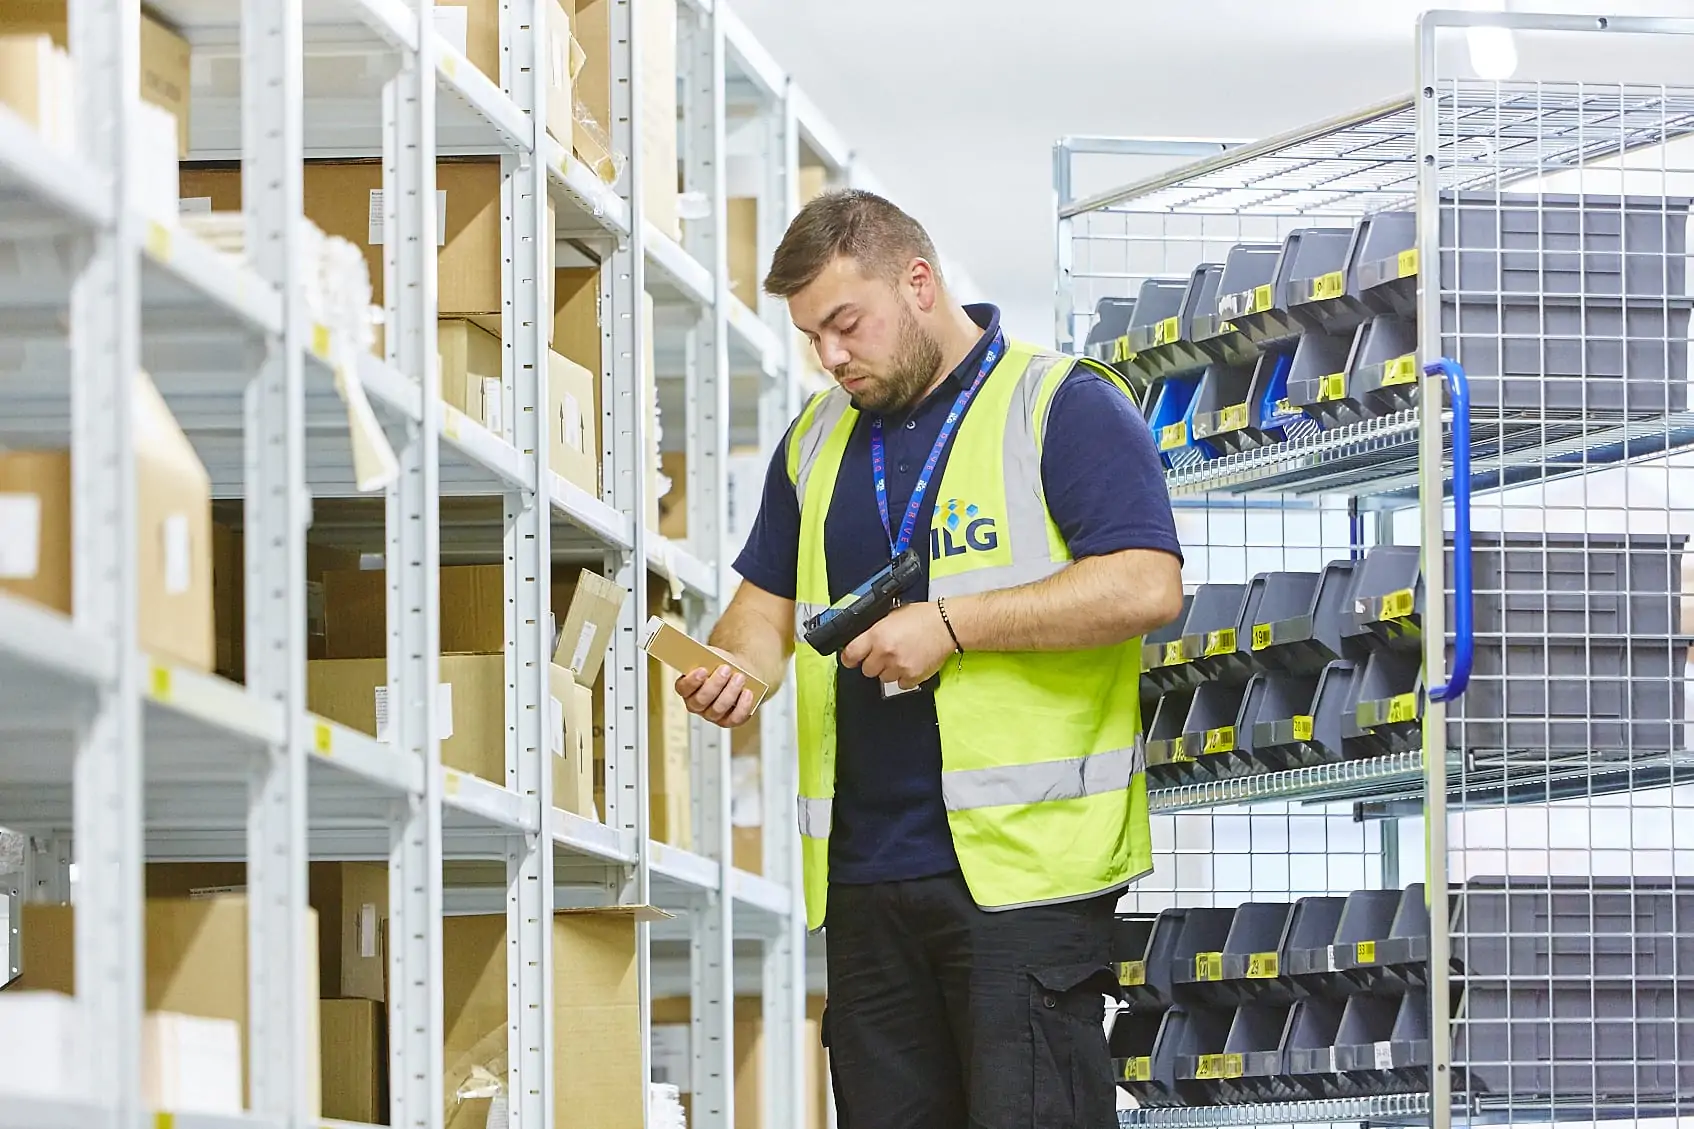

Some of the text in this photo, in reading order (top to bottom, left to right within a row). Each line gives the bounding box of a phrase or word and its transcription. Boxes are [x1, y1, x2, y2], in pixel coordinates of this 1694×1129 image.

[926, 432, 949, 471] DRIVE
[900, 502, 921, 544] DRIVE
[930, 517, 998, 562] ILG
[1254, 630, 1263, 645] 19
[1294, 720, 1302, 732] 20
[1358, 943, 1366, 956] 33
